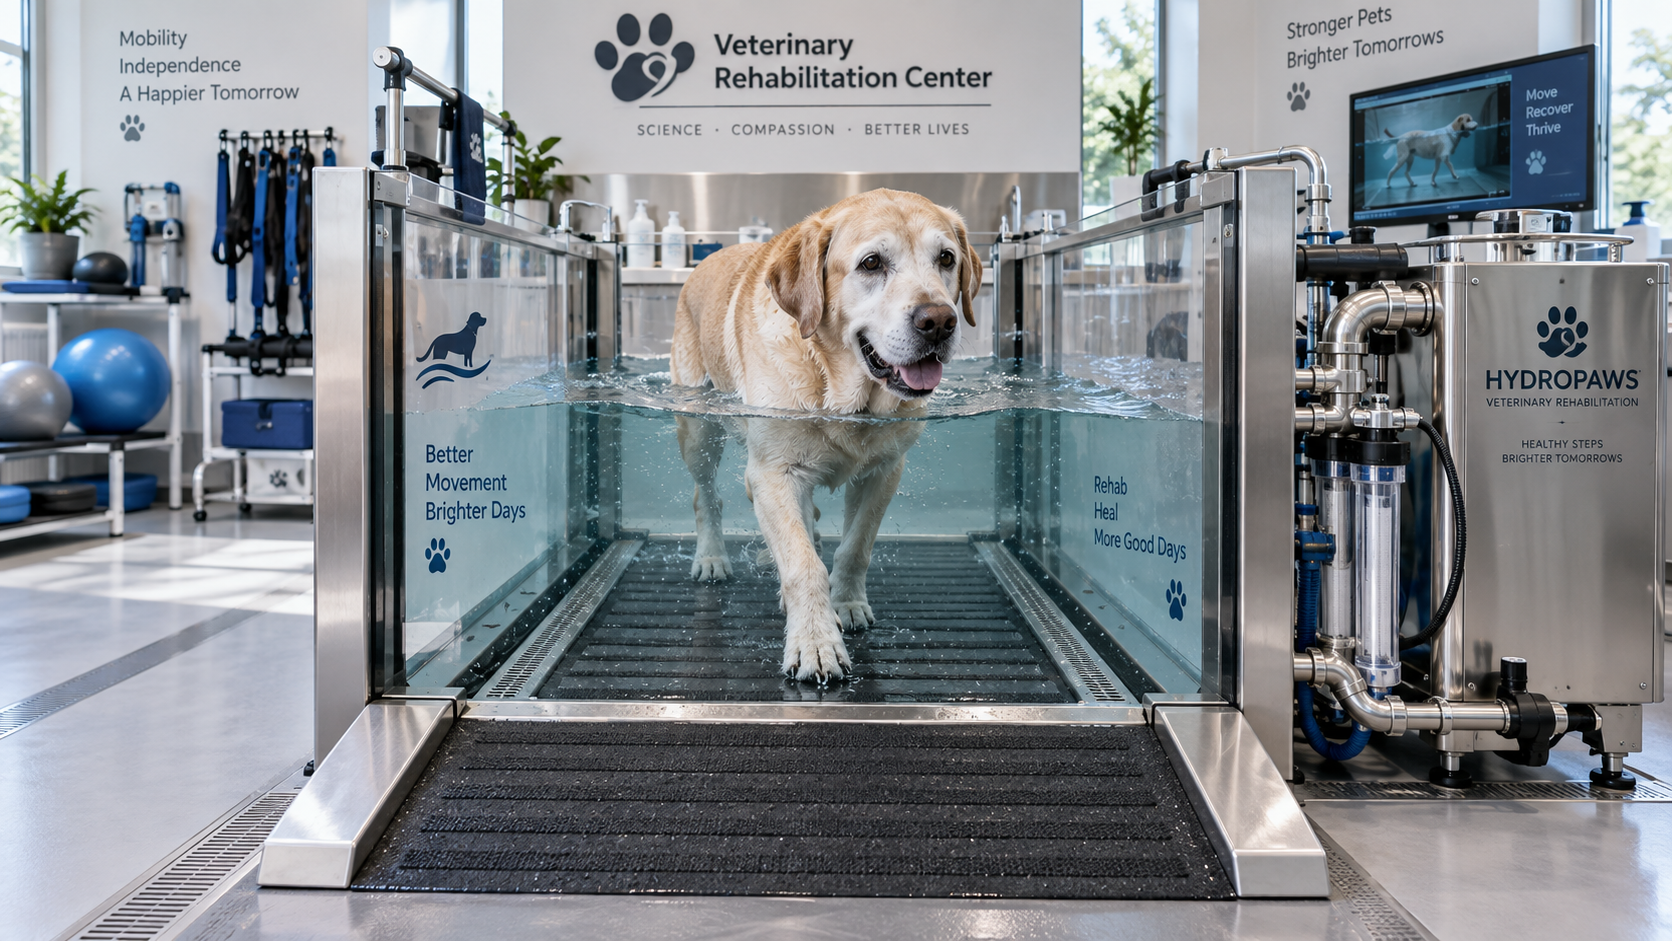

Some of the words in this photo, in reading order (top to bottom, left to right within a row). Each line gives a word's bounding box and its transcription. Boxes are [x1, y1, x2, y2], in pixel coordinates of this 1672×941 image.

[1287, 15, 1354, 40] Stronger
[1358, 6, 1393, 27] Pets
[119, 28, 188, 50] Mobility
[713, 32, 854, 61] Veterinary
[1287, 45, 1349, 70] Brighter
[1353, 29, 1445, 58] Tomorrows
[119, 55, 242, 78] Independence
[715, 65, 898, 89] Rehabilitation
[904, 65, 993, 89] Center
[119, 85, 133, 102] A
[137, 84, 206, 106] Happier
[210, 83, 300, 101] Tomorrow
[1526, 87, 1559, 103] Move
[1526, 99, 1575, 119] Recover
[637, 123, 702, 137] SCIENCE
[731, 123, 835, 136] COMPASSION
[864, 123, 921, 136] BETTER
[928, 122, 970, 136] LIVES
[1525, 121, 1562, 137] Thrive
[1485, 397, 1553, 408] VETERINARY
[1555, 397, 1639, 408] REHABILITATION
[425, 443, 475, 464] Better
[1521, 439, 1569, 449] HEALTHY
[1572, 439, 1604, 449] STEPS
[1502, 453, 1553, 464] BRIGHTER
[1555, 453, 1623, 464] TOMORROWS
[425, 472, 508, 492] Movement
[1094, 475, 1128, 496] Rehab
[425, 500, 488, 526] Brighter
[491, 500, 526, 524] Days
[1094, 501, 1119, 522] Heal
[1094, 527, 1122, 549] More
[1123, 531, 1155, 554] Good
[1157, 536, 1187, 564] Days
